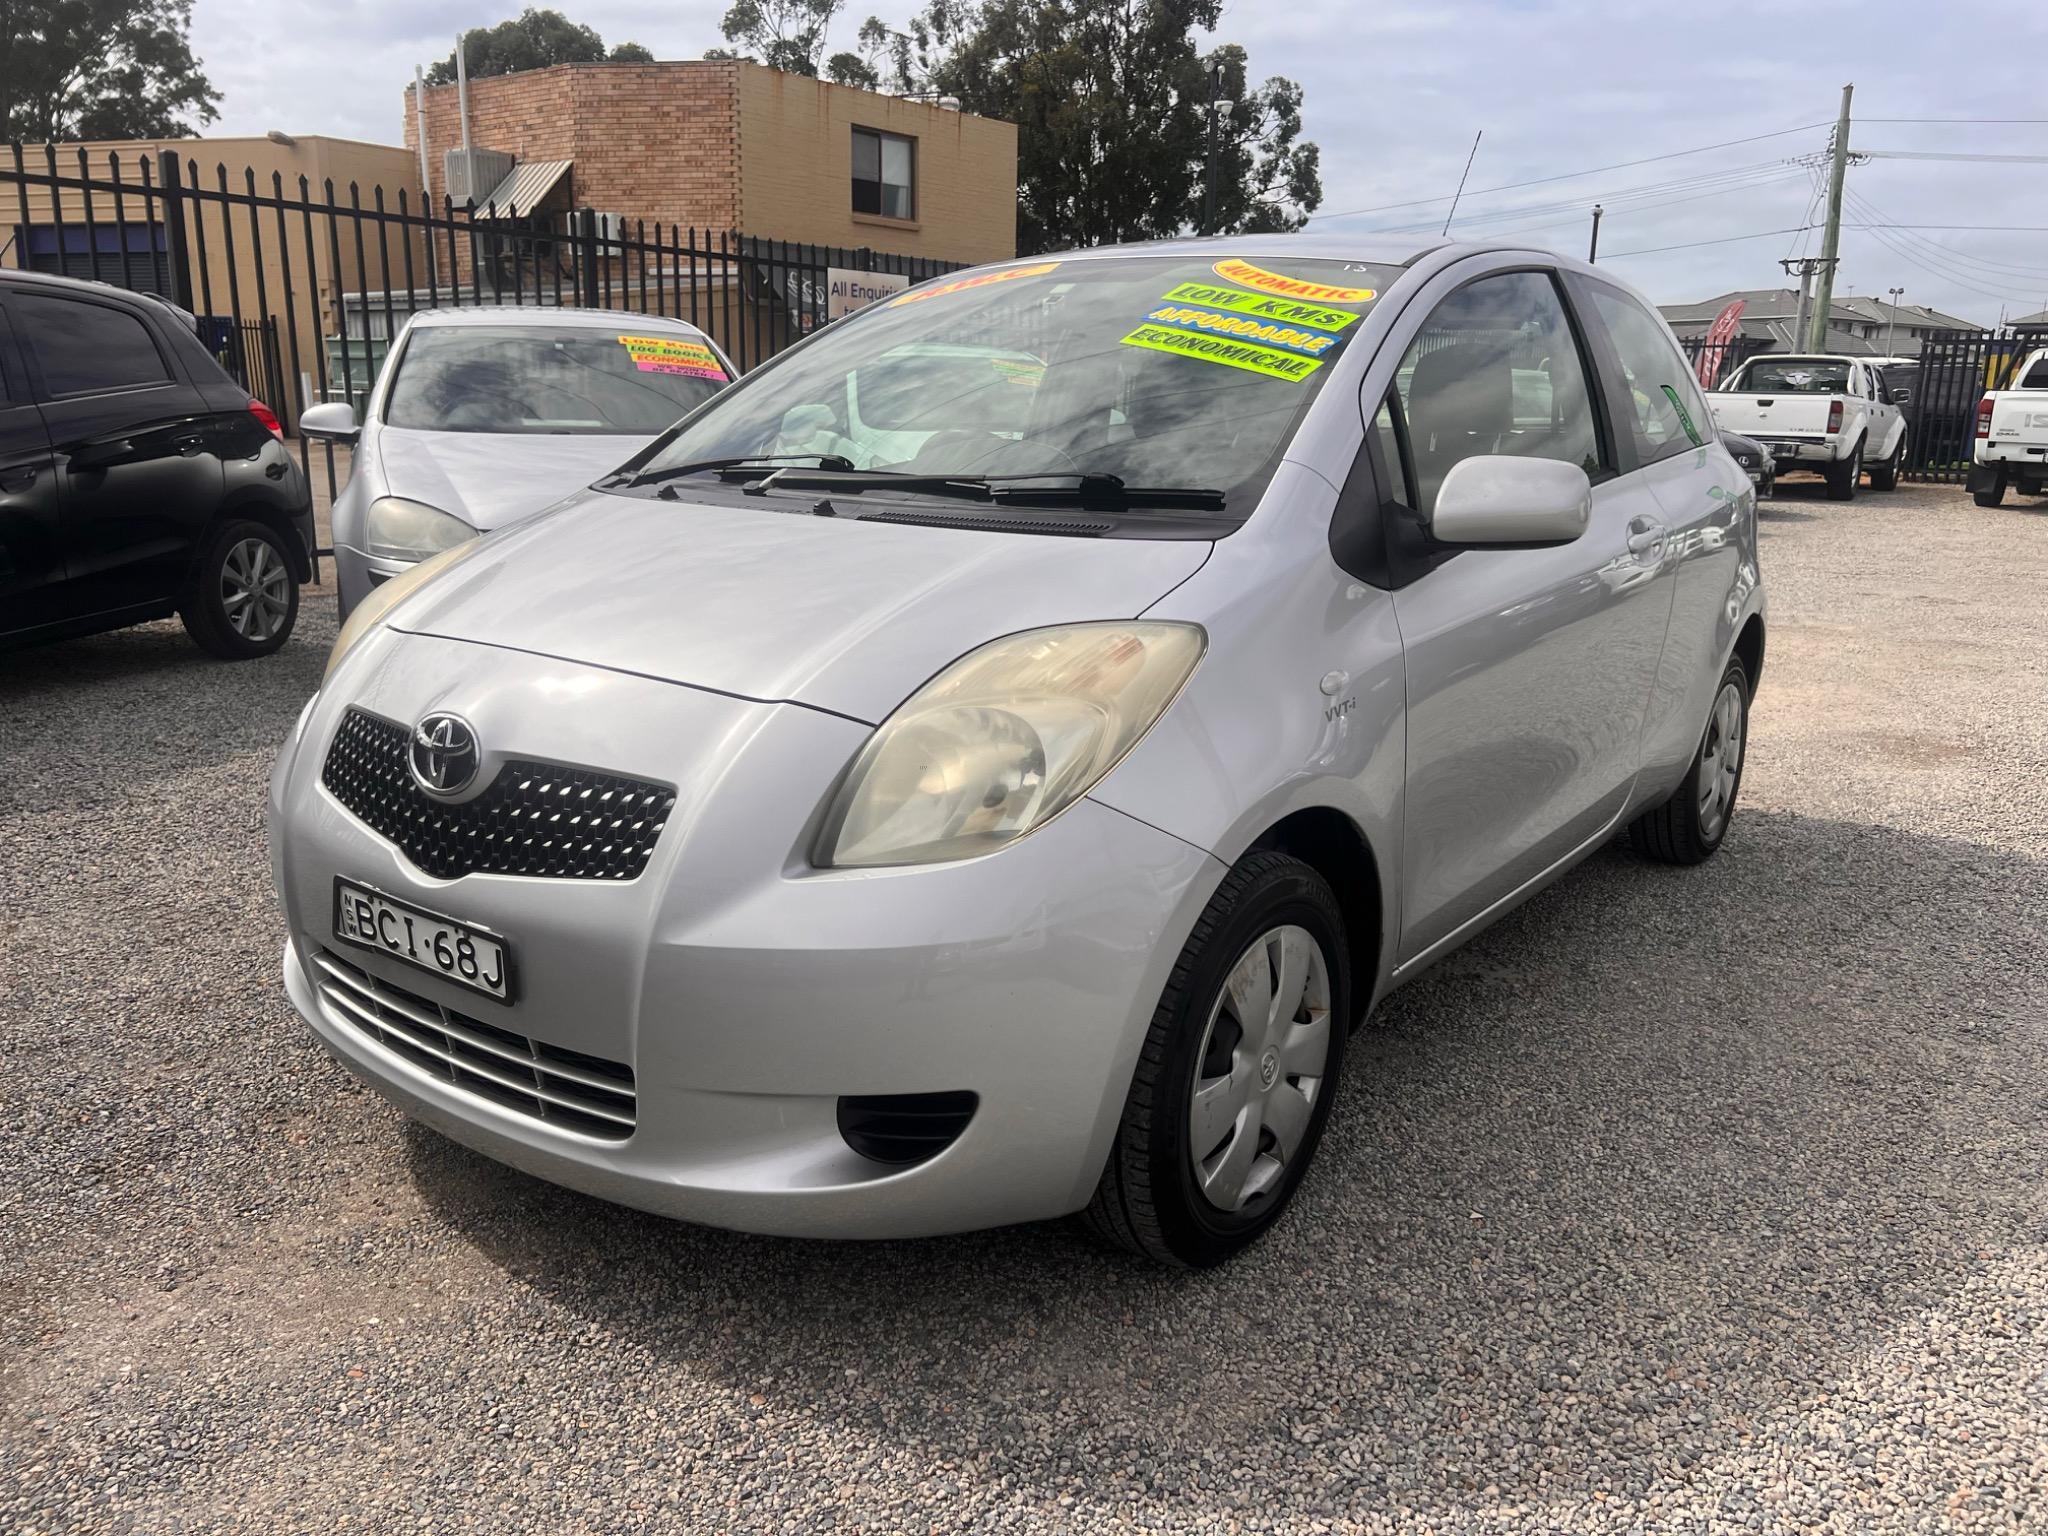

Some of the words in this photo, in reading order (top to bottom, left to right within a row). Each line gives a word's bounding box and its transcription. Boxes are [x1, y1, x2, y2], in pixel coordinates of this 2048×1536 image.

[831, 281, 847, 297] All
[851, 283, 898, 302] Enquiri
[1223, 264, 1358, 300] AUTOMATIC
[1173, 286, 1249, 306] LOW
[1251, 300, 1345, 327] KMS
[1148, 306, 1334, 353] AFFORDABLE
[631, 345, 657, 354] LOG
[637, 354, 719, 370] ECONOMICAL
[1130, 328, 1310, 376] ECONOMICAL
